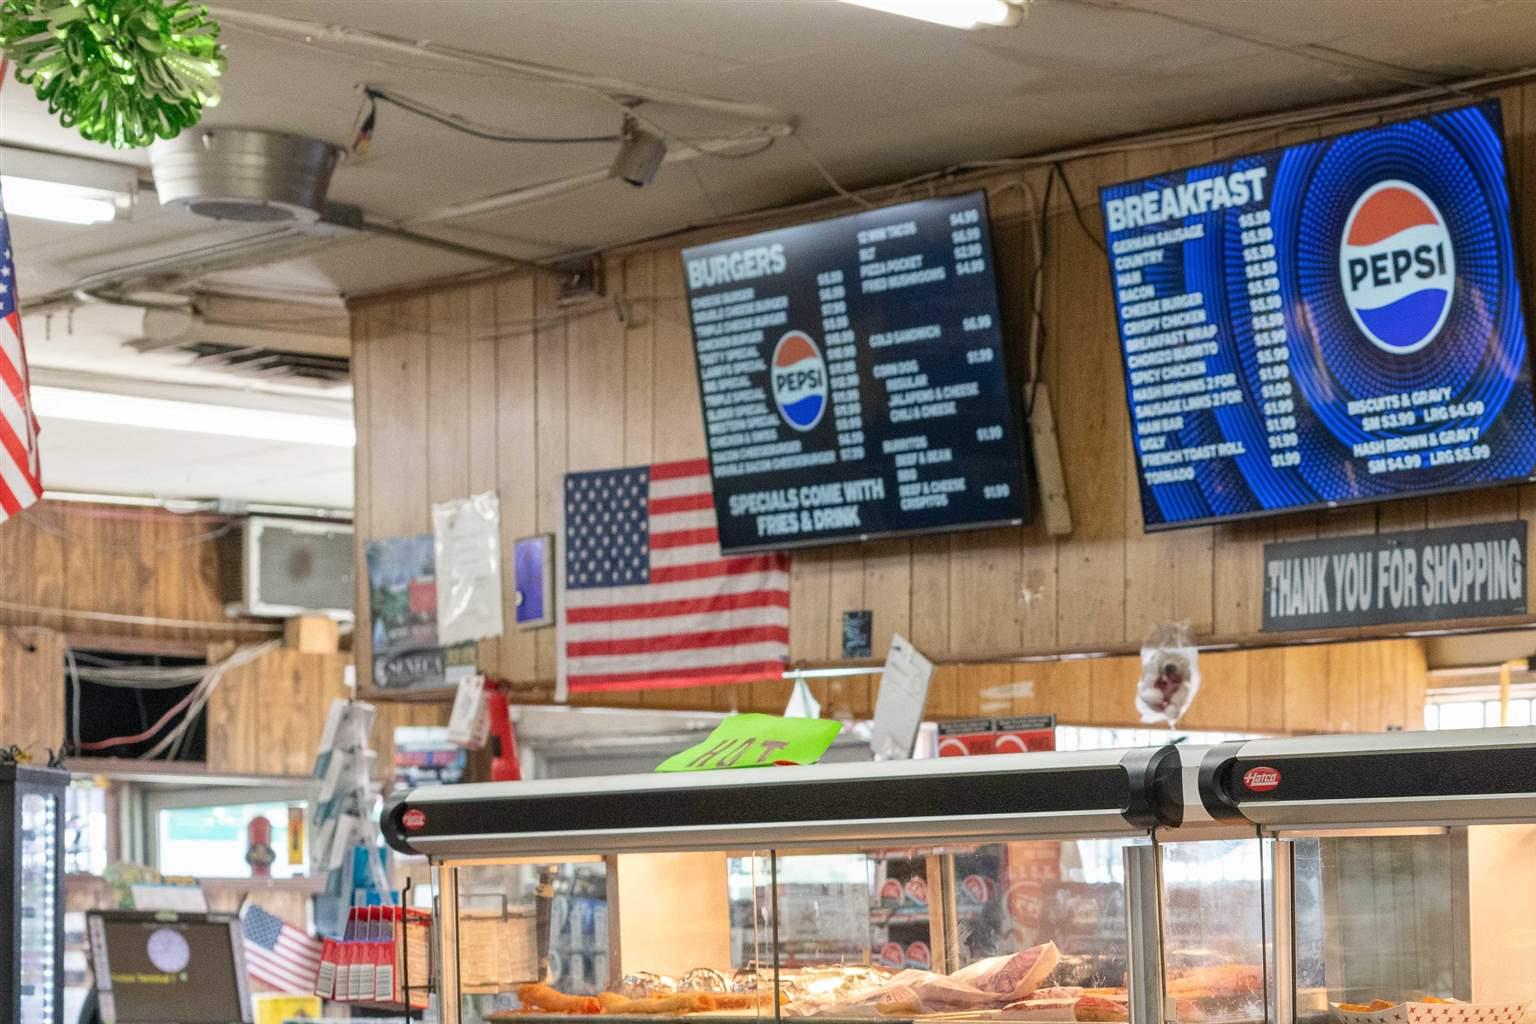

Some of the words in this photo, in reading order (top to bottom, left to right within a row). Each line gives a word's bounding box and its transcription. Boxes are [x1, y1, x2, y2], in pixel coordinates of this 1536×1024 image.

[1106, 166, 1268, 232] BREAKFAST
[1157, 223, 1205, 247] SAUSAGE
[687, 243, 787, 290] BURGERS
[1114, 249, 1164, 271] COUNTRY
[1348, 241, 1447, 292] PEPSI
[1119, 284, 1155, 303] BACON
[1121, 299, 1159, 319] CHEESE
[1160, 292, 1203, 313] BURGER
[1123, 317, 1160, 336] CRISPY
[1161, 309, 1206, 330] CHICKEN
[1126, 331, 1185, 353] BREAKFAST
[1185, 324, 1218, 343] WRAP
[1172, 341, 1219, 363] BURRITO
[775, 369, 823, 393] PEPSI
[1130, 369, 1161, 386] SPICY
[1161, 360, 1207, 381] CHICKEN
[1214, 373, 1236, 389] FOR
[1220, 389, 1243, 406] FOR
[1347, 394, 1400, 416] BISCUITS
[1411, 386, 1453, 407] GRAVY
[1362, 415, 1380, 432] SM
[1423, 405, 1448, 422] LRG
[1449, 400, 1485, 420] $4.99
[1141, 449, 1183, 468] FRENCH
[1183, 444, 1217, 462] TOAST
[1217, 441, 1246, 457] ROLL
[1353, 441, 1386, 457] HASH
[1386, 434, 1427, 453] BROWN
[1438, 427, 1480, 447] GRAVY
[1368, 458, 1387, 474] SM
[1387, 453, 1422, 472] $4.99
[1430, 448, 1454, 465] LRG
[728, 488, 799, 517] SPECIALS
[799, 483, 843, 508] COME
[843, 477, 885, 503] WITH
[756, 511, 799, 537] FRIES
[813, 504, 862, 531] DRINK
[1267, 556, 1329, 618] THANK
[1332, 552, 1373, 612] YOU
[1378, 548, 1418, 610] FOR
[1421, 537, 1523, 607] SHOPPING
[687, 737, 789, 768] HOT
[1244, 771, 1278, 787] Hatco
